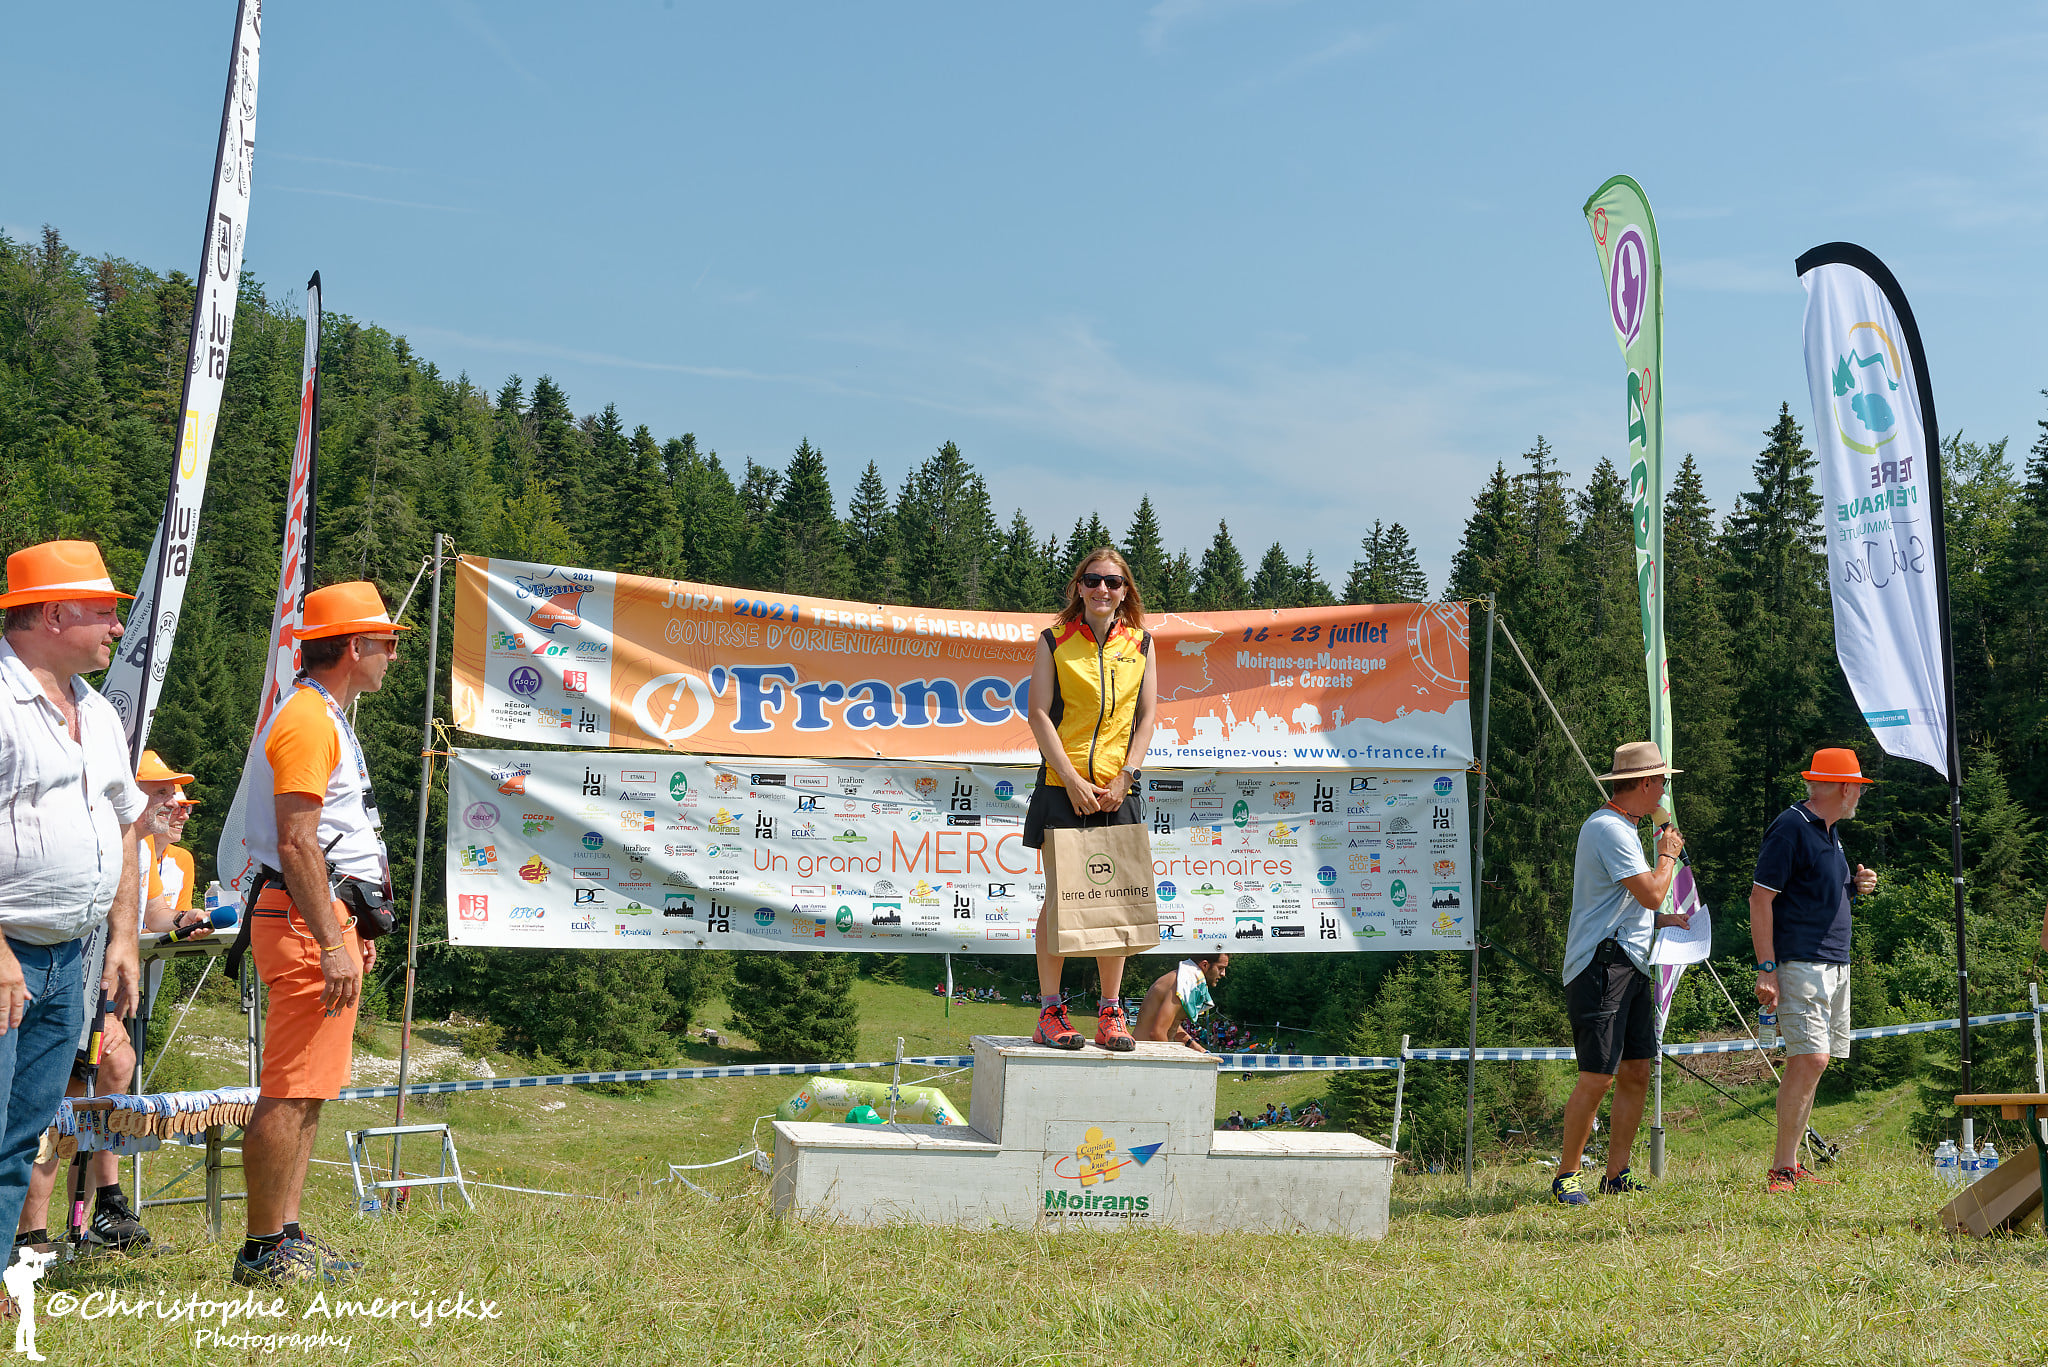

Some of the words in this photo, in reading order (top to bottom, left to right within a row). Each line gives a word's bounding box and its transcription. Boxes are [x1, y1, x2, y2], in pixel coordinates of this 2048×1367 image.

[166, 543, 187, 578] ra
[573, 573, 593, 581] 2021
[661, 590, 724, 613] JURA
[734, 598, 800, 623] 2021
[810, 607, 884, 632] TERRE
[892, 614, 1036, 642] D'ÉMERAUDE
[664, 618, 759, 648] COURSE
[767, 624, 942, 658] D'ORIENTATION
[1243, 627, 1270, 642] 16
[1291, 625, 1321, 643] 23
[1327, 622, 1389, 649] juillet
[1236, 650, 1386, 674] Moirans-en-Montagne
[1270, 670, 1294, 687] Les
[1299, 670, 1353, 689] Crozets
[538, 707, 559, 716] Côte
[538, 716, 559, 724] d'Or
[578, 723, 595, 733] ra
[1176, 747, 1288, 761] renseignez-vous:
[1294, 744, 1447, 760] www.o-france.fr
[583, 785, 600, 796] ra
[951, 798, 972, 811] ra
[1314, 800, 1333, 813] ra
[621, 810, 642, 819] Côte
[621, 819, 642, 828] d'Or
[708, 825, 740, 833] Moirans
[1154, 823, 1171, 834] ra
[1433, 819, 1450, 829] ra
[755, 828, 773, 839] ra
[1190, 826, 1210, 834] Côte
[1190, 834, 1210, 842] d'Or
[1268, 837, 1298, 845] Moirans
[754, 848, 788, 871] Un
[797, 851, 882, 879] grand
[892, 830, 1043, 875] MERCI
[1349, 853, 1368, 862] Côte
[1152, 855, 1293, 876] artenaires
[1349, 862, 1368, 870] d'Or
[1062, 890, 1085, 901] terre
[1088, 889, 1101, 899] de
[1105, 885, 1149, 899] running
[954, 908, 970, 919] ra
[708, 919, 730, 932] ra
[792, 918, 813, 926] Côte
[792, 926, 814, 934] d'Or
[1320, 929, 1337, 939] ra
[1080, 1141, 1113, 1155] Capitale
[1045, 1190, 1149, 1210] Moirans
[1064, 1211, 1149, 1219] montagne
